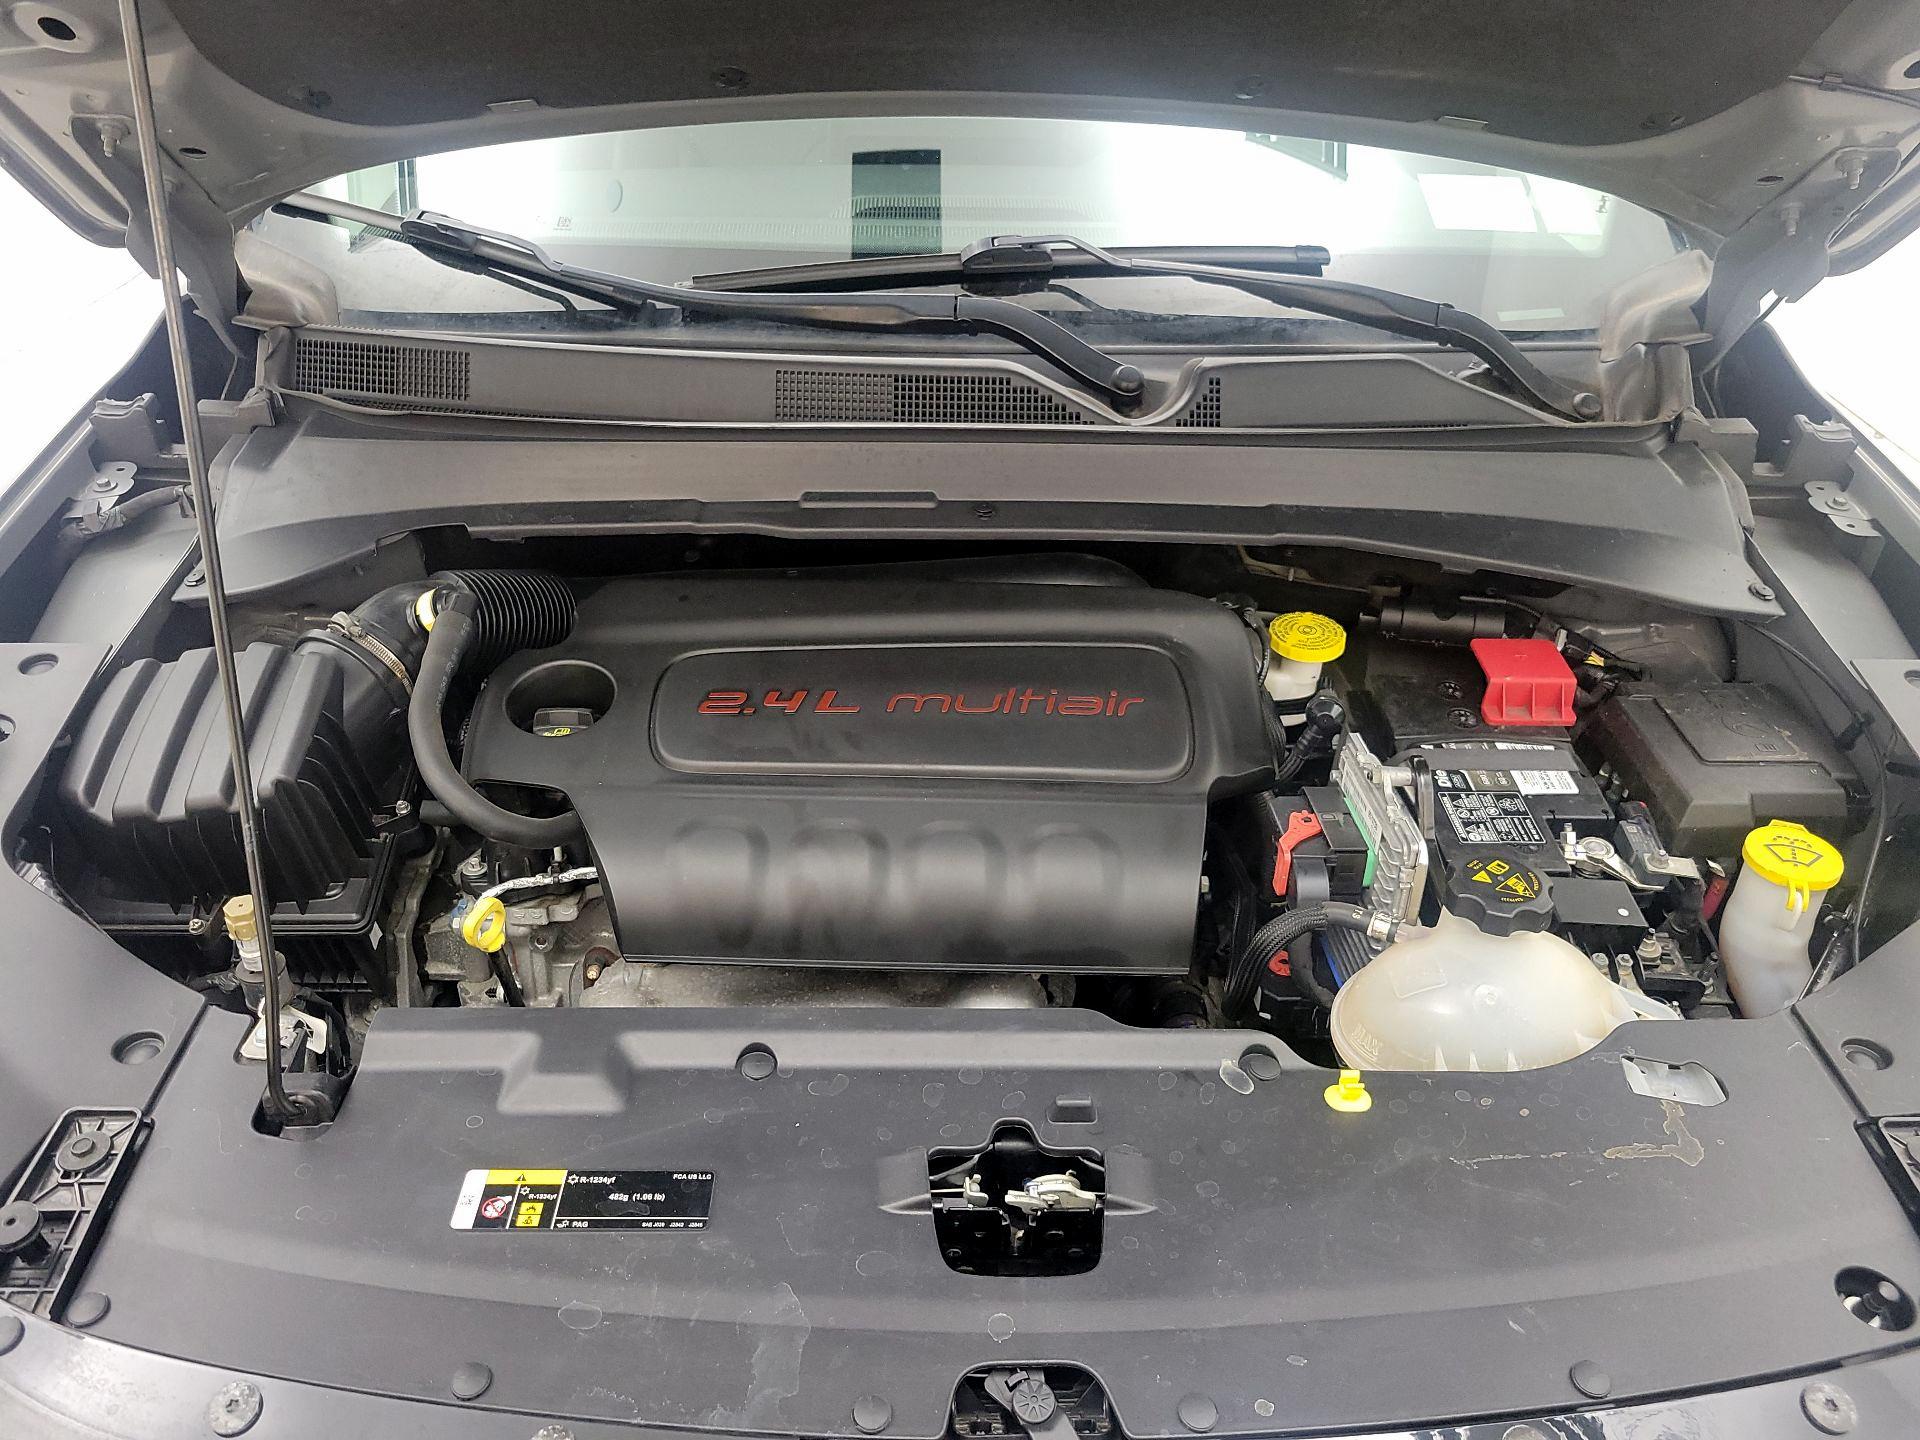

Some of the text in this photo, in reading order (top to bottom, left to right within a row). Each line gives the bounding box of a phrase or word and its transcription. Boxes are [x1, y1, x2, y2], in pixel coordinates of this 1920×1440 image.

[885, 687, 1145, 717] multiair
[579, 1176, 616, 1185] R-1234yf
[608, 1193, 629, 1202] 482g
